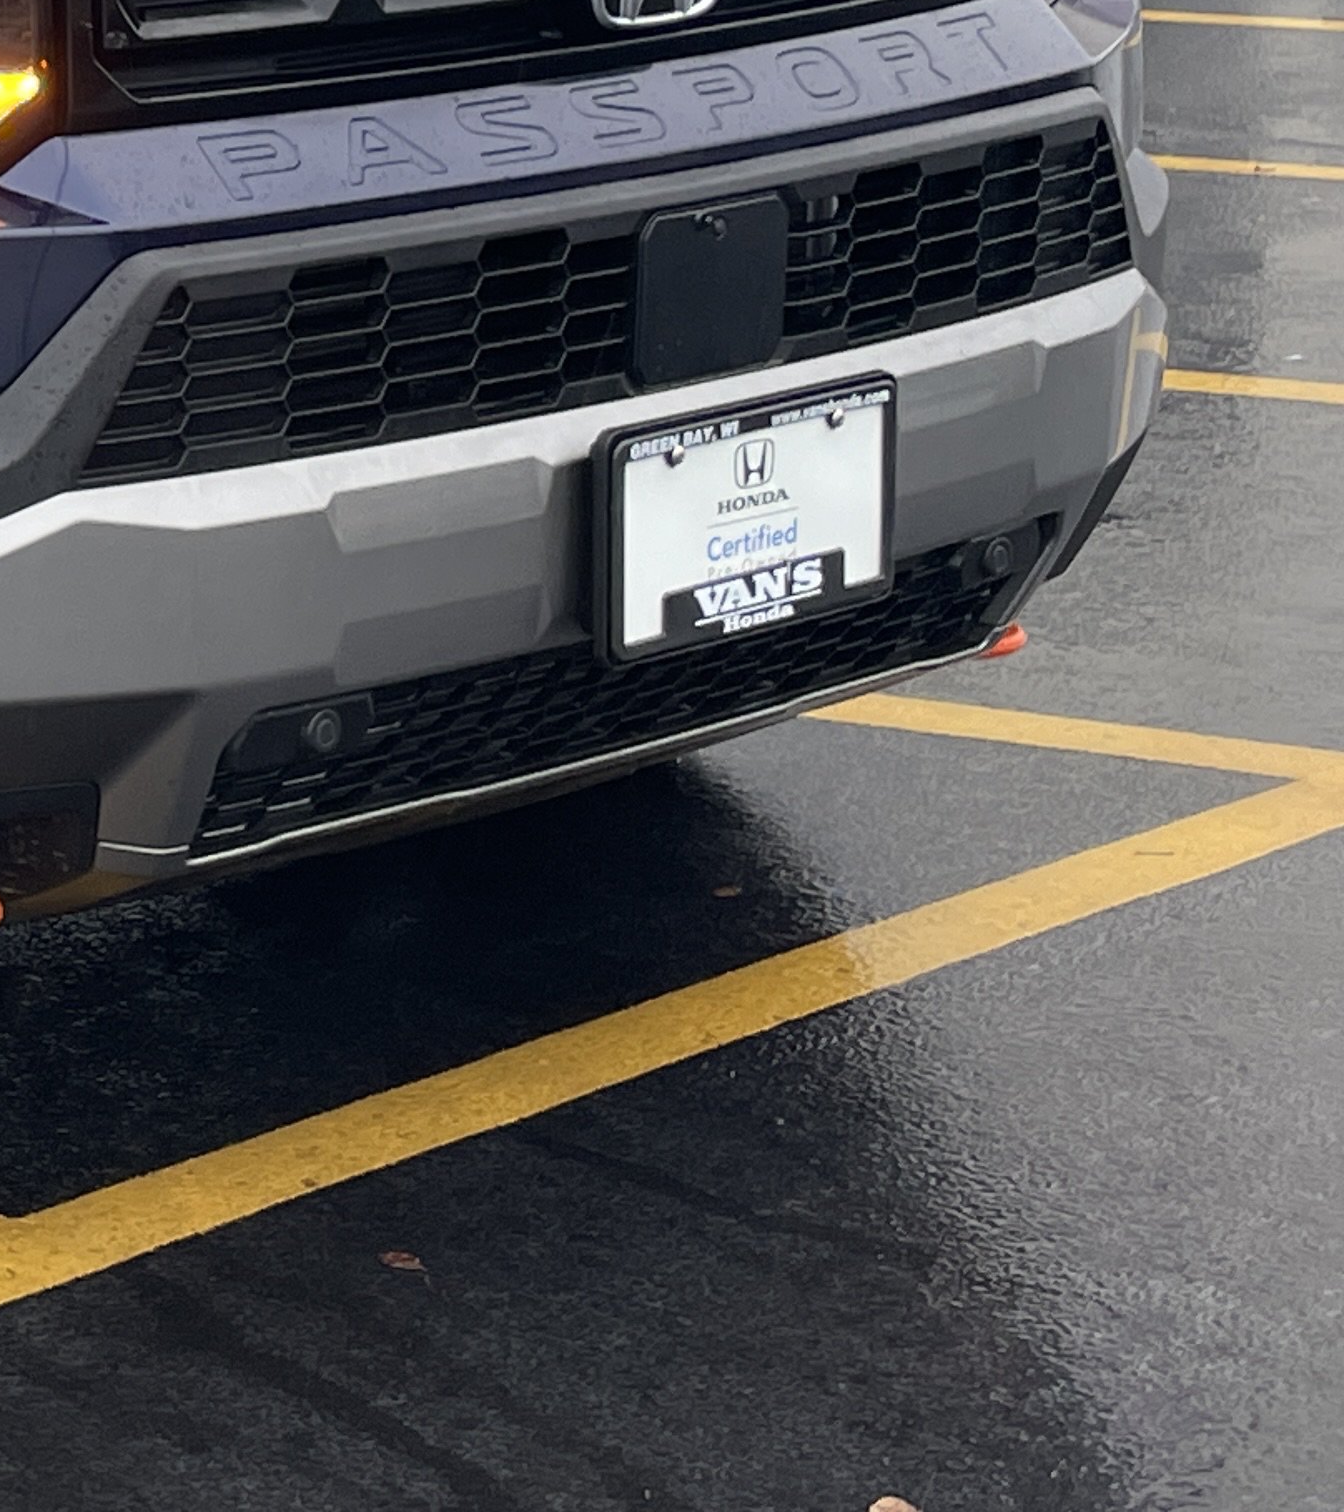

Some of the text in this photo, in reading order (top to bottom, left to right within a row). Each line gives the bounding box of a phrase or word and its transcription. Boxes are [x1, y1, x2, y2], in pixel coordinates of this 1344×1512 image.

[196, 11, 1009, 201] PASSPORT
[630, 433, 681, 460] GREEN
[720, 419, 739, 439] WI
[717, 488, 790, 515] HONDA
[707, 516, 798, 561] Certified
[723, 603, 796, 634] Honda
